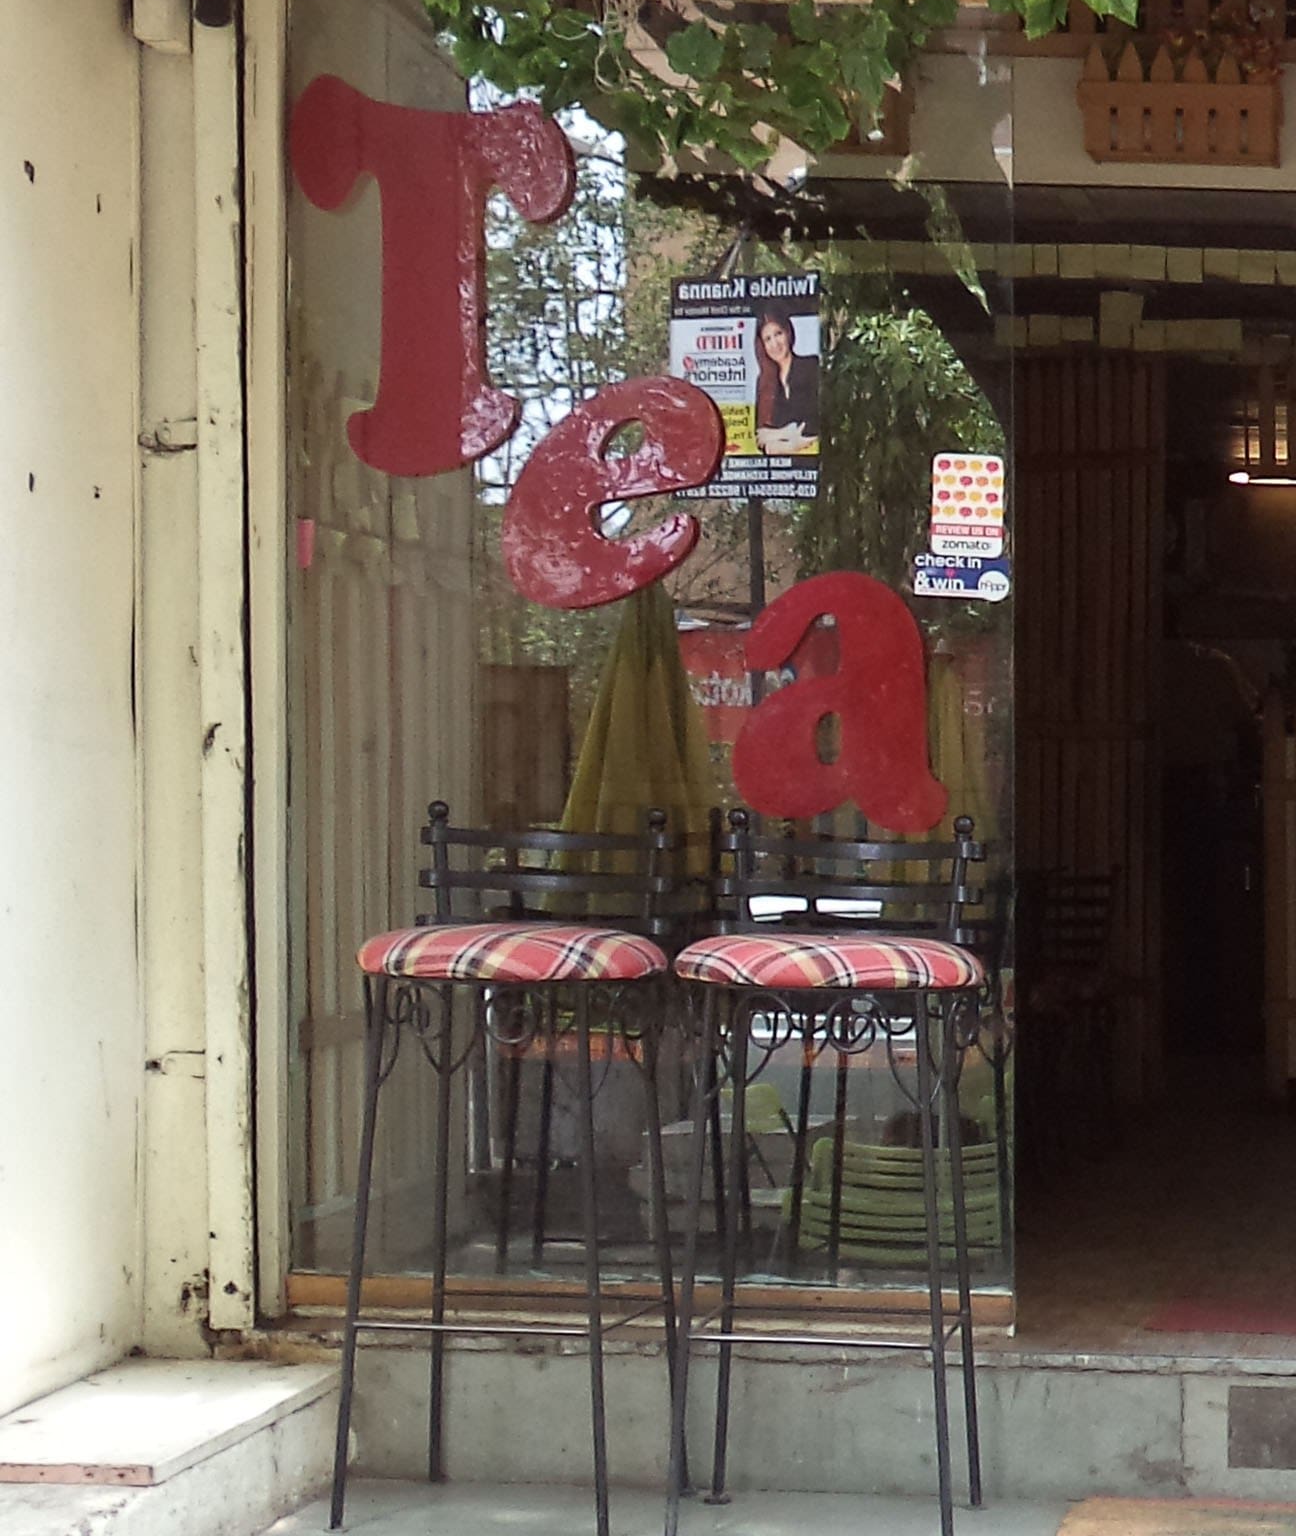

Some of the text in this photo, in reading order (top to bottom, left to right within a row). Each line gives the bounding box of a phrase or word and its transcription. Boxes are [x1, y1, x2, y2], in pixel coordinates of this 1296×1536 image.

[942, 539, 990, 551] zomato
[915, 554, 981, 569] check in
[915, 570, 964, 591] & win
